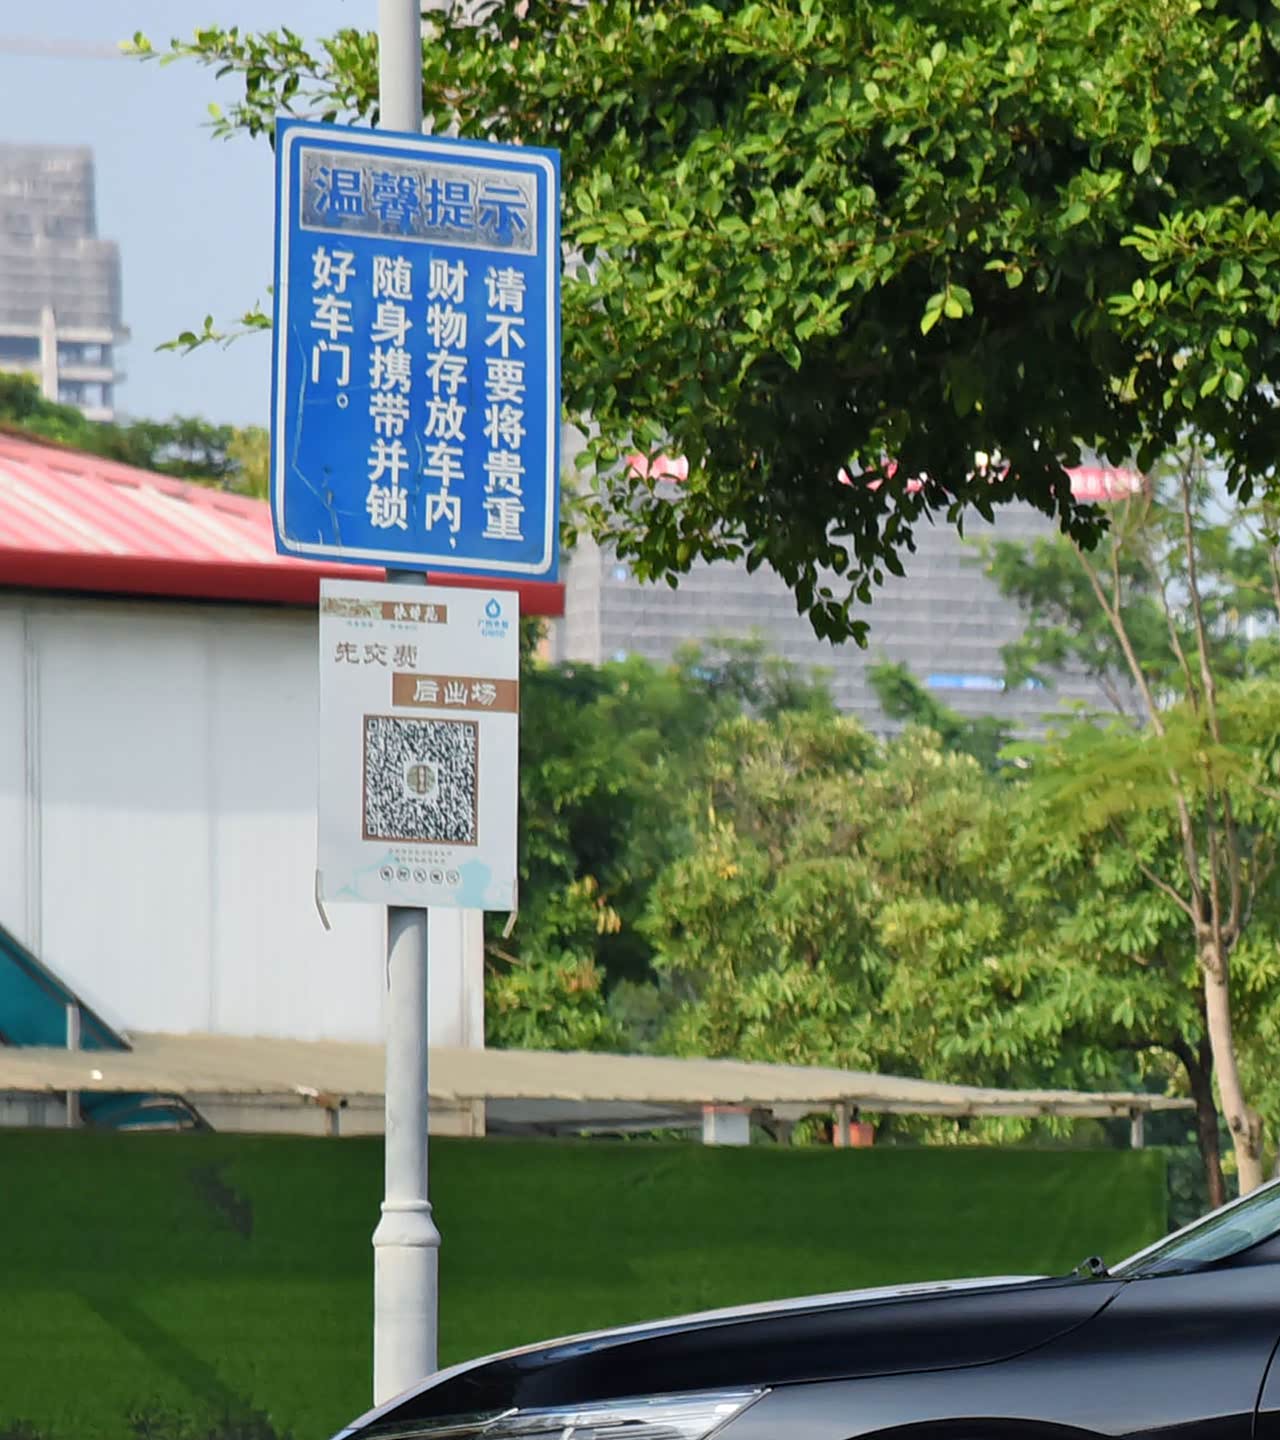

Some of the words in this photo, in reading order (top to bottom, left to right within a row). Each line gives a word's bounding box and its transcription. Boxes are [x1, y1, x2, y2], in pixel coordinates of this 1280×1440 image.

[313, 166, 528, 234] 温馨提示
[366, 255, 413, 530] 随身携带并锁
[482, 265, 527, 541] 请不要将贵重
[334, 641, 418, 669] 先交费
